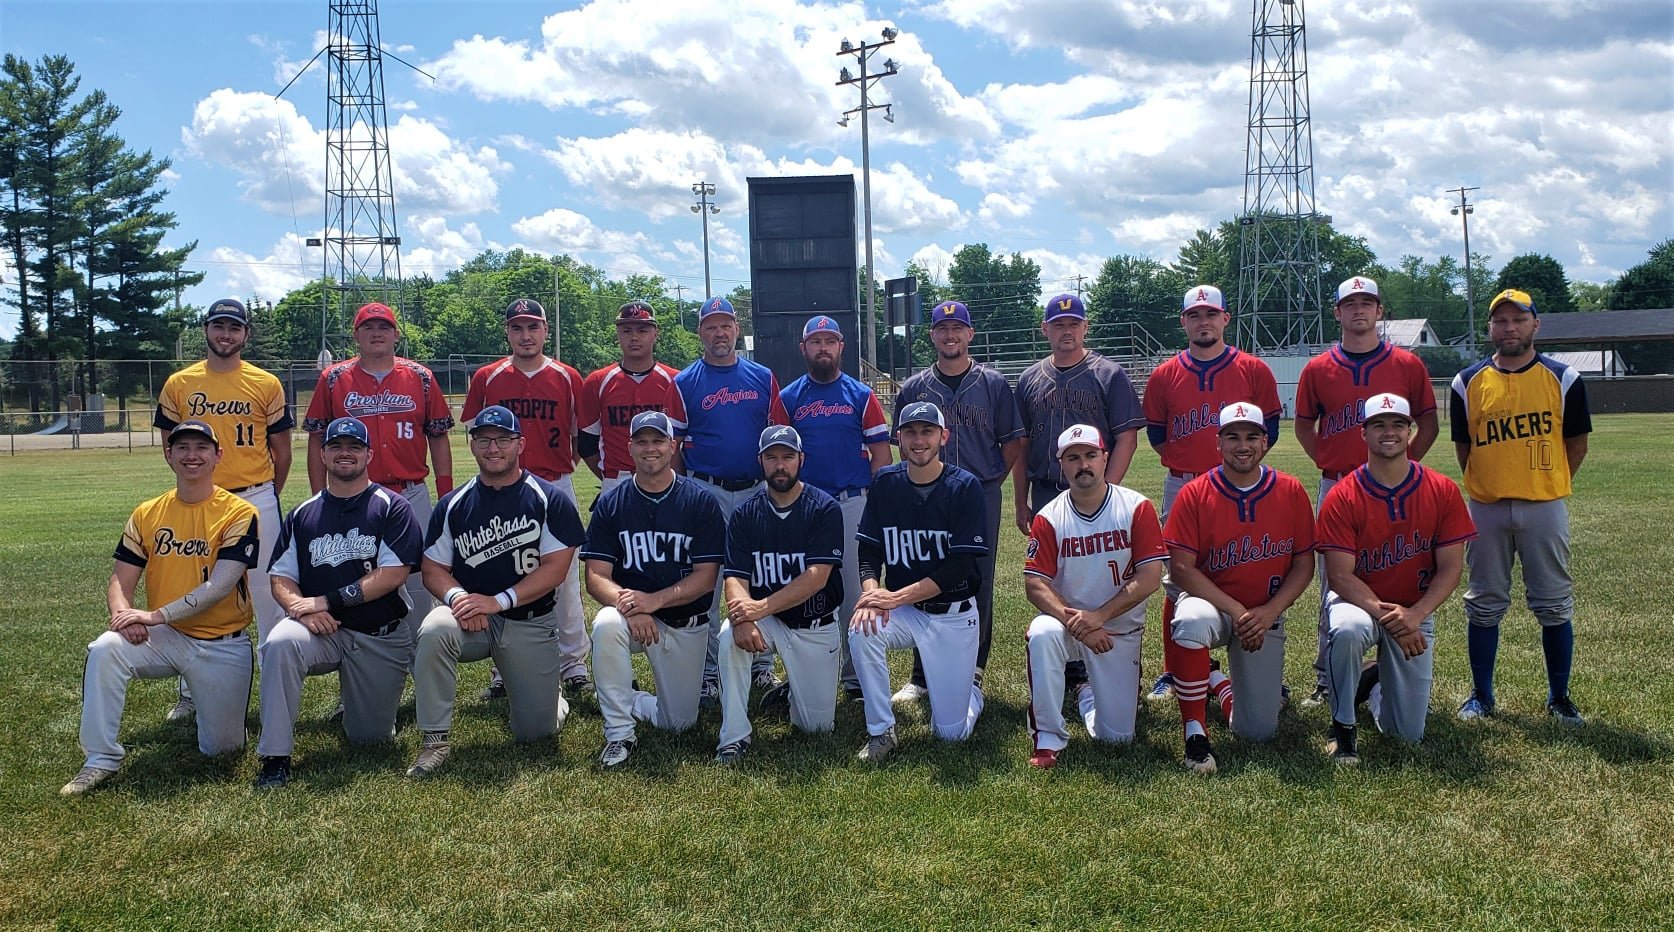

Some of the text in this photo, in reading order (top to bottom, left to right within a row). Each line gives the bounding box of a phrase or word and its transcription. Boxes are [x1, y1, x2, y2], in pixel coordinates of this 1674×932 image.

[187, 392, 252, 417] Brews
[235, 422, 255, 448] 11
[396, 421, 414, 440] 15
[548, 427, 561, 449] 2
[1475, 411, 1553, 447] LAKERS
[1526, 439, 1554, 471] 10
[483, 538, 522, 559] BASEBALL
[363, 561, 373, 575] 9
[512, 548, 541, 576] 16
